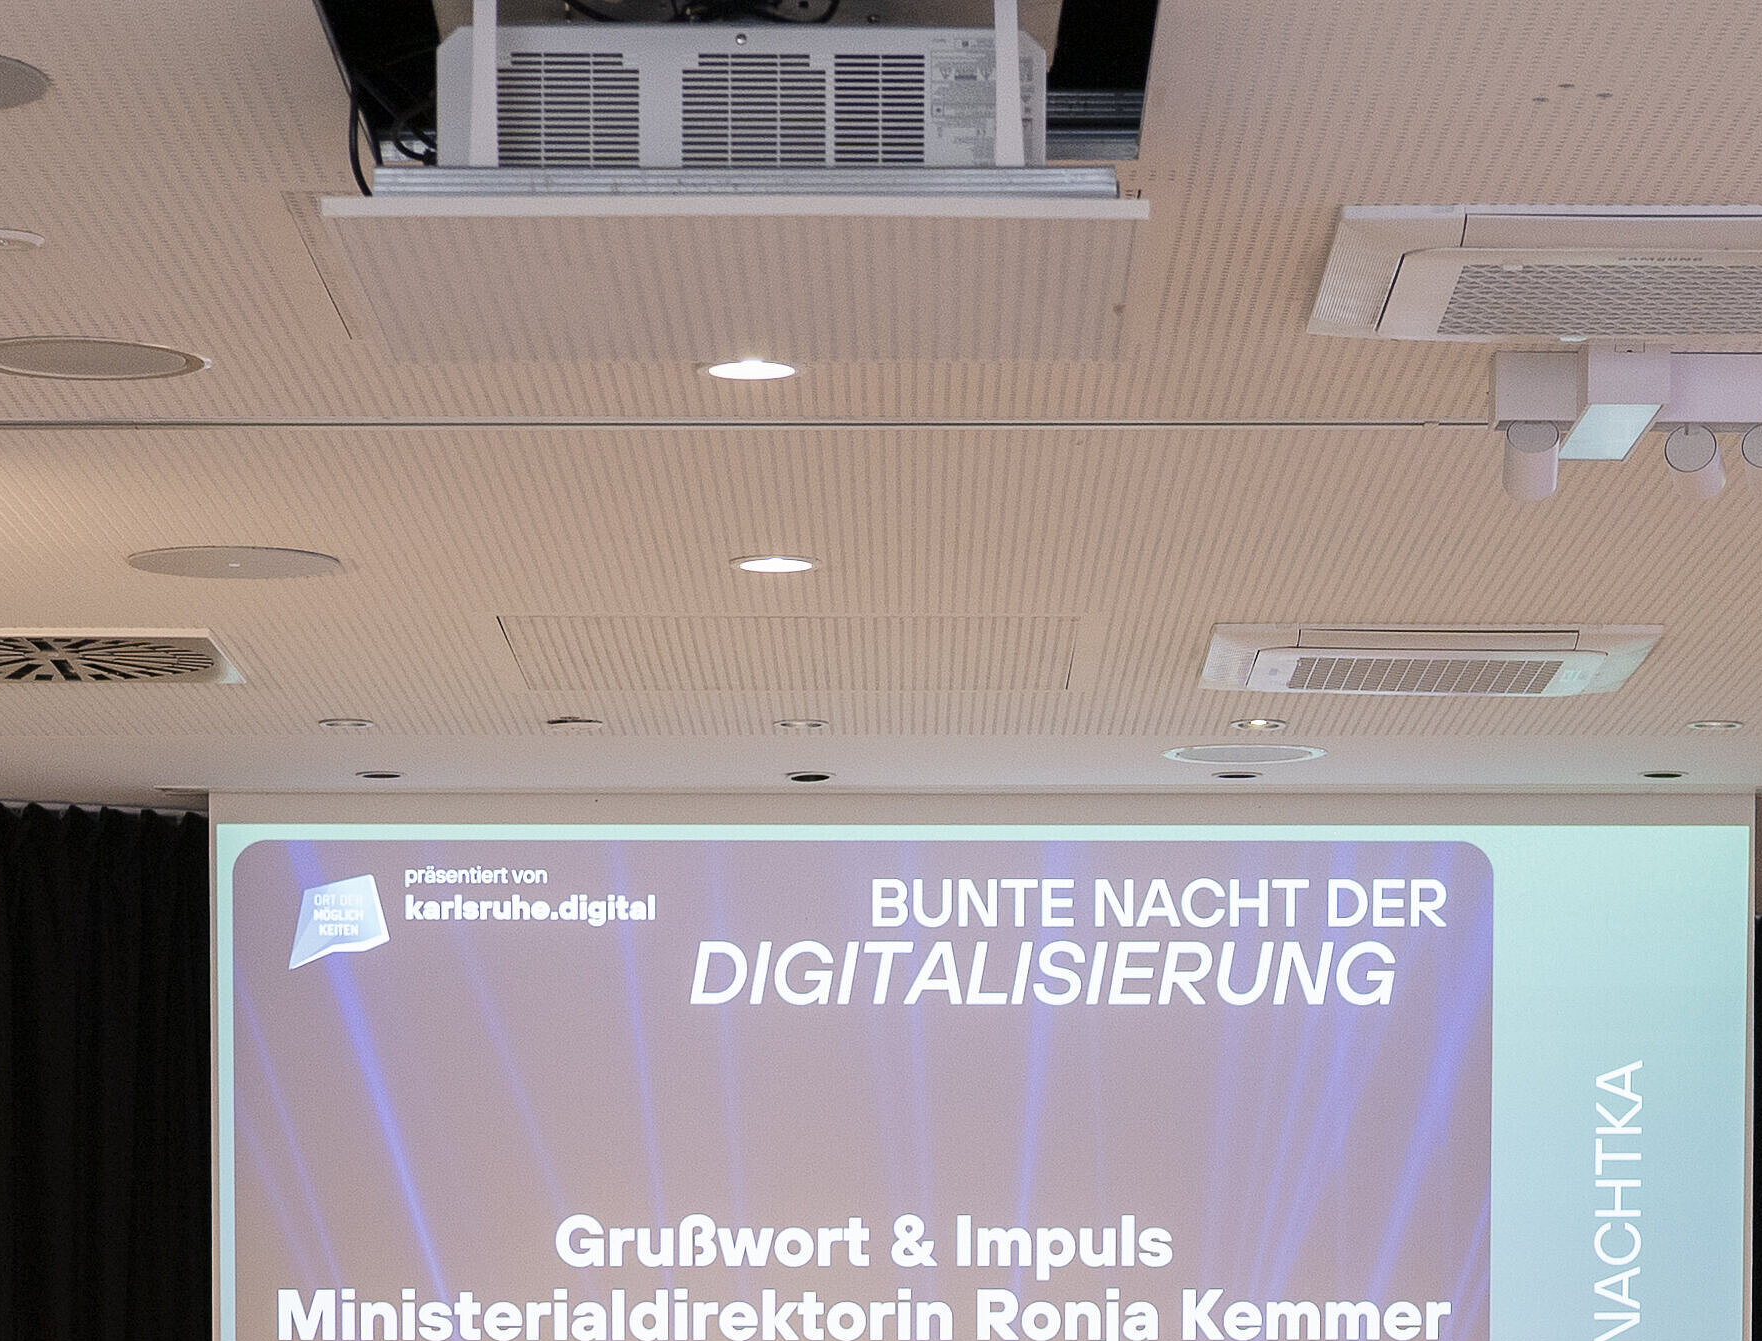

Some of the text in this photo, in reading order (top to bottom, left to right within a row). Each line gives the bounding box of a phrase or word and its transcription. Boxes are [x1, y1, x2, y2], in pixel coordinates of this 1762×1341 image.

[404, 865, 548, 888] präsentiert von
[404, 894, 657, 927] karlsruhe.digital
[872, 878, 1447, 928] BUNTE NACHT DER
[689, 940, 1397, 1007] DIGITALISIERUNG
[555, 1213, 1173, 1281] Grußwort & Impuls
[278, 1288, 953, 1341] Ministerialdirektorin
[1182, 1288, 1452, 1341] Kemmer
